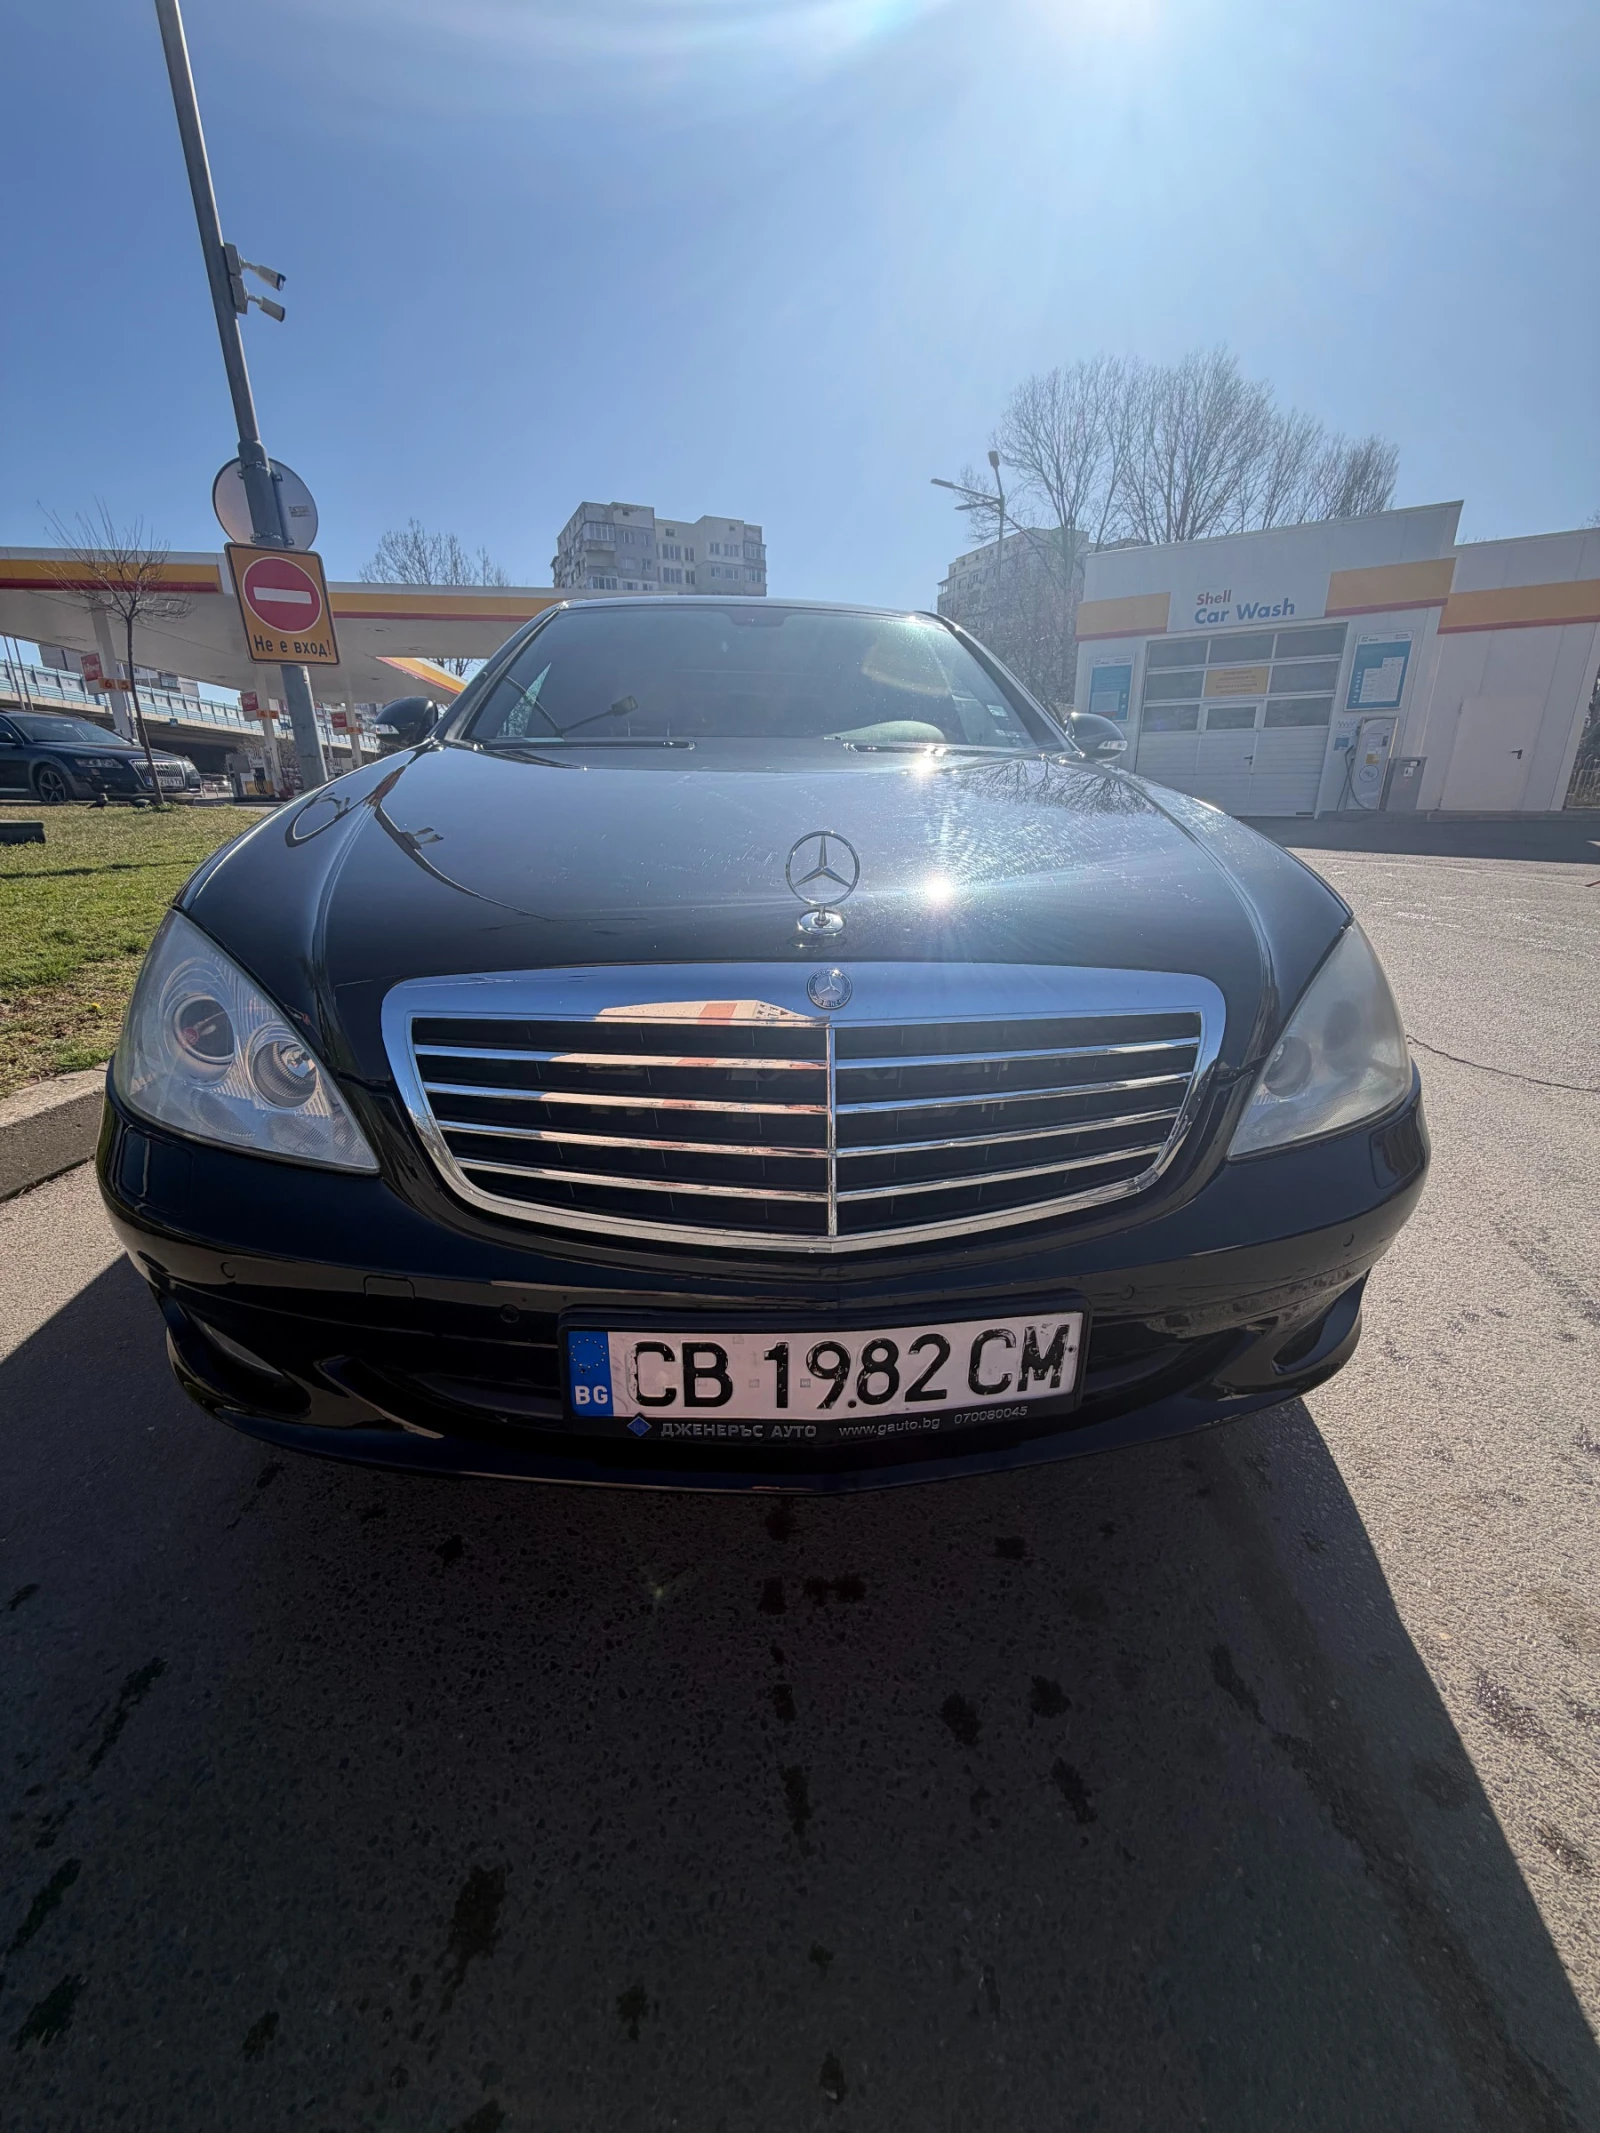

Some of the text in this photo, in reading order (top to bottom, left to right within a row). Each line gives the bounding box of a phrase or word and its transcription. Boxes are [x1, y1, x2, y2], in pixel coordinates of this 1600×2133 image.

[1196, 589, 1232, 606] Shell
[1194, 597, 1295, 625] Car Wash
[253, 635, 274, 652] Не
[104, 680, 113, 689] 6
[763, 1332, 951, 1410] 1982
[573, 1384, 609, 1405] BG
[953, 1405, 1029, 1425] 070080045
[770, 1424, 818, 1438] АУТО
[838, 1416, 941, 1437] www.gauto.bg
